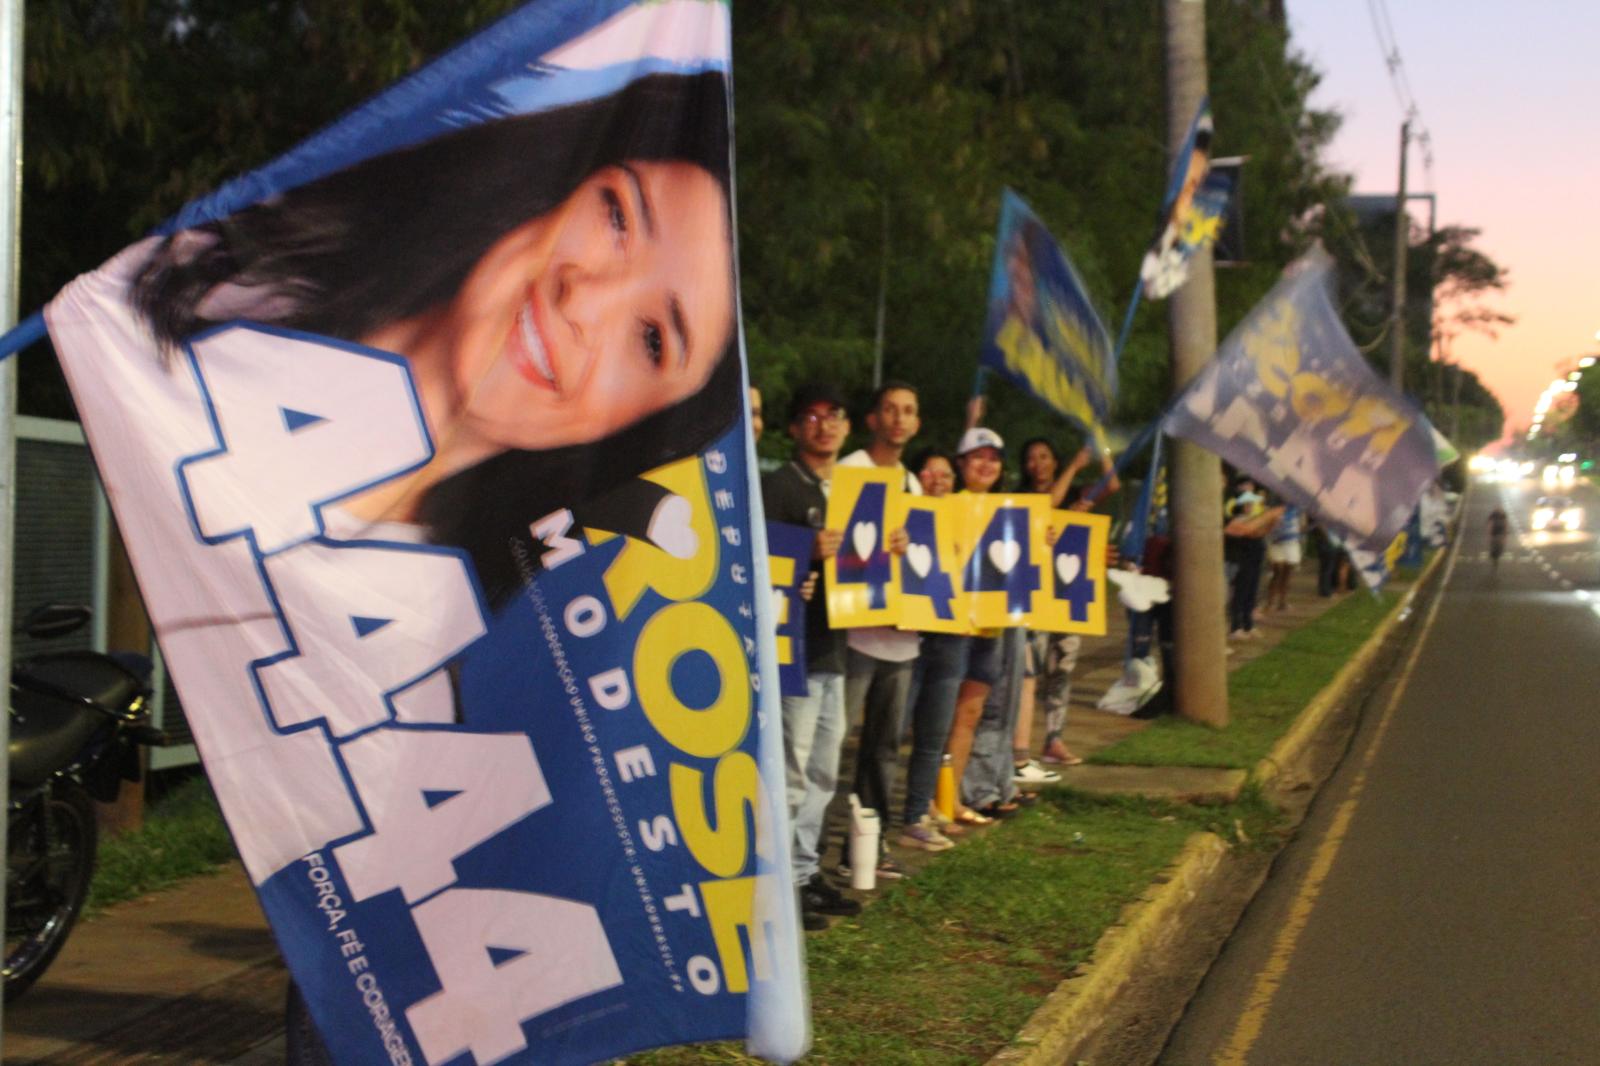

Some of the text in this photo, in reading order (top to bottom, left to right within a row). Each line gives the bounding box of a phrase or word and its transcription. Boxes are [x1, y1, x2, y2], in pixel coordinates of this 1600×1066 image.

[836, 482, 1095, 622] 4 4 4 4
[180, 322, 625, 1066] 4444
[529, 507, 721, 996] MODESTO
[583, 455, 780, 993] ROSE
[302, 852, 347, 932] FORÇA,
[337, 928, 365, 958] FÉ
[348, 955, 369, 976] E
